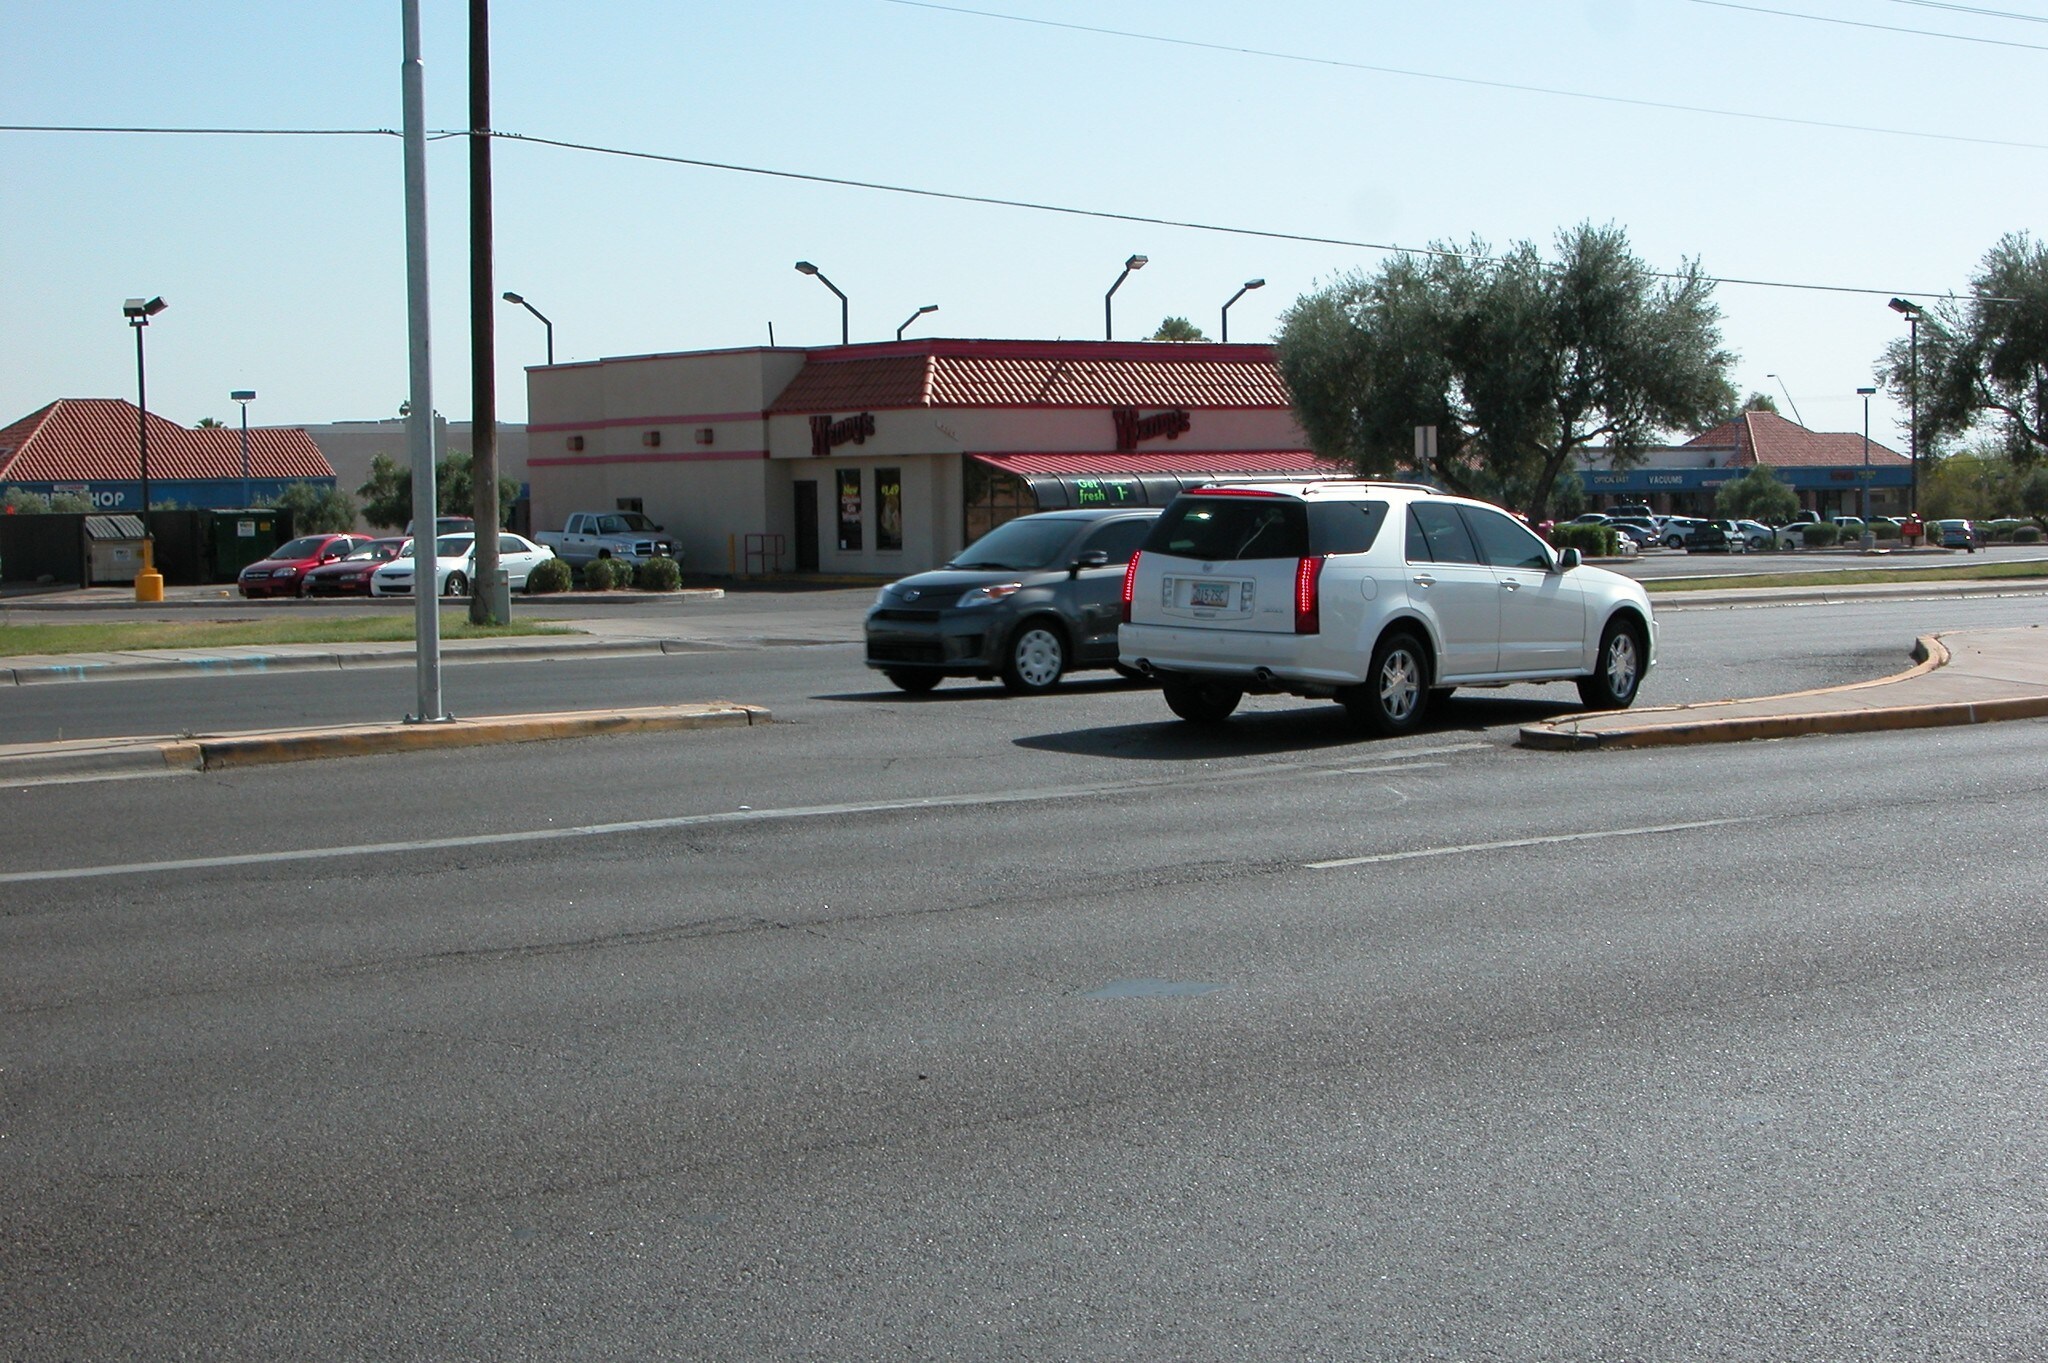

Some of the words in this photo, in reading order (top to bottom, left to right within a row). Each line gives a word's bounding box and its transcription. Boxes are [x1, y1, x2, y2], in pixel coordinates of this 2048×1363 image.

[809, 412, 875, 455] Wendy's
[1112, 408, 1191, 450] Wendy's
[1077, 479, 1098, 488] Get
[1648, 475, 1683, 484] VACUUMS
[1080, 489, 1105, 504] fresh
